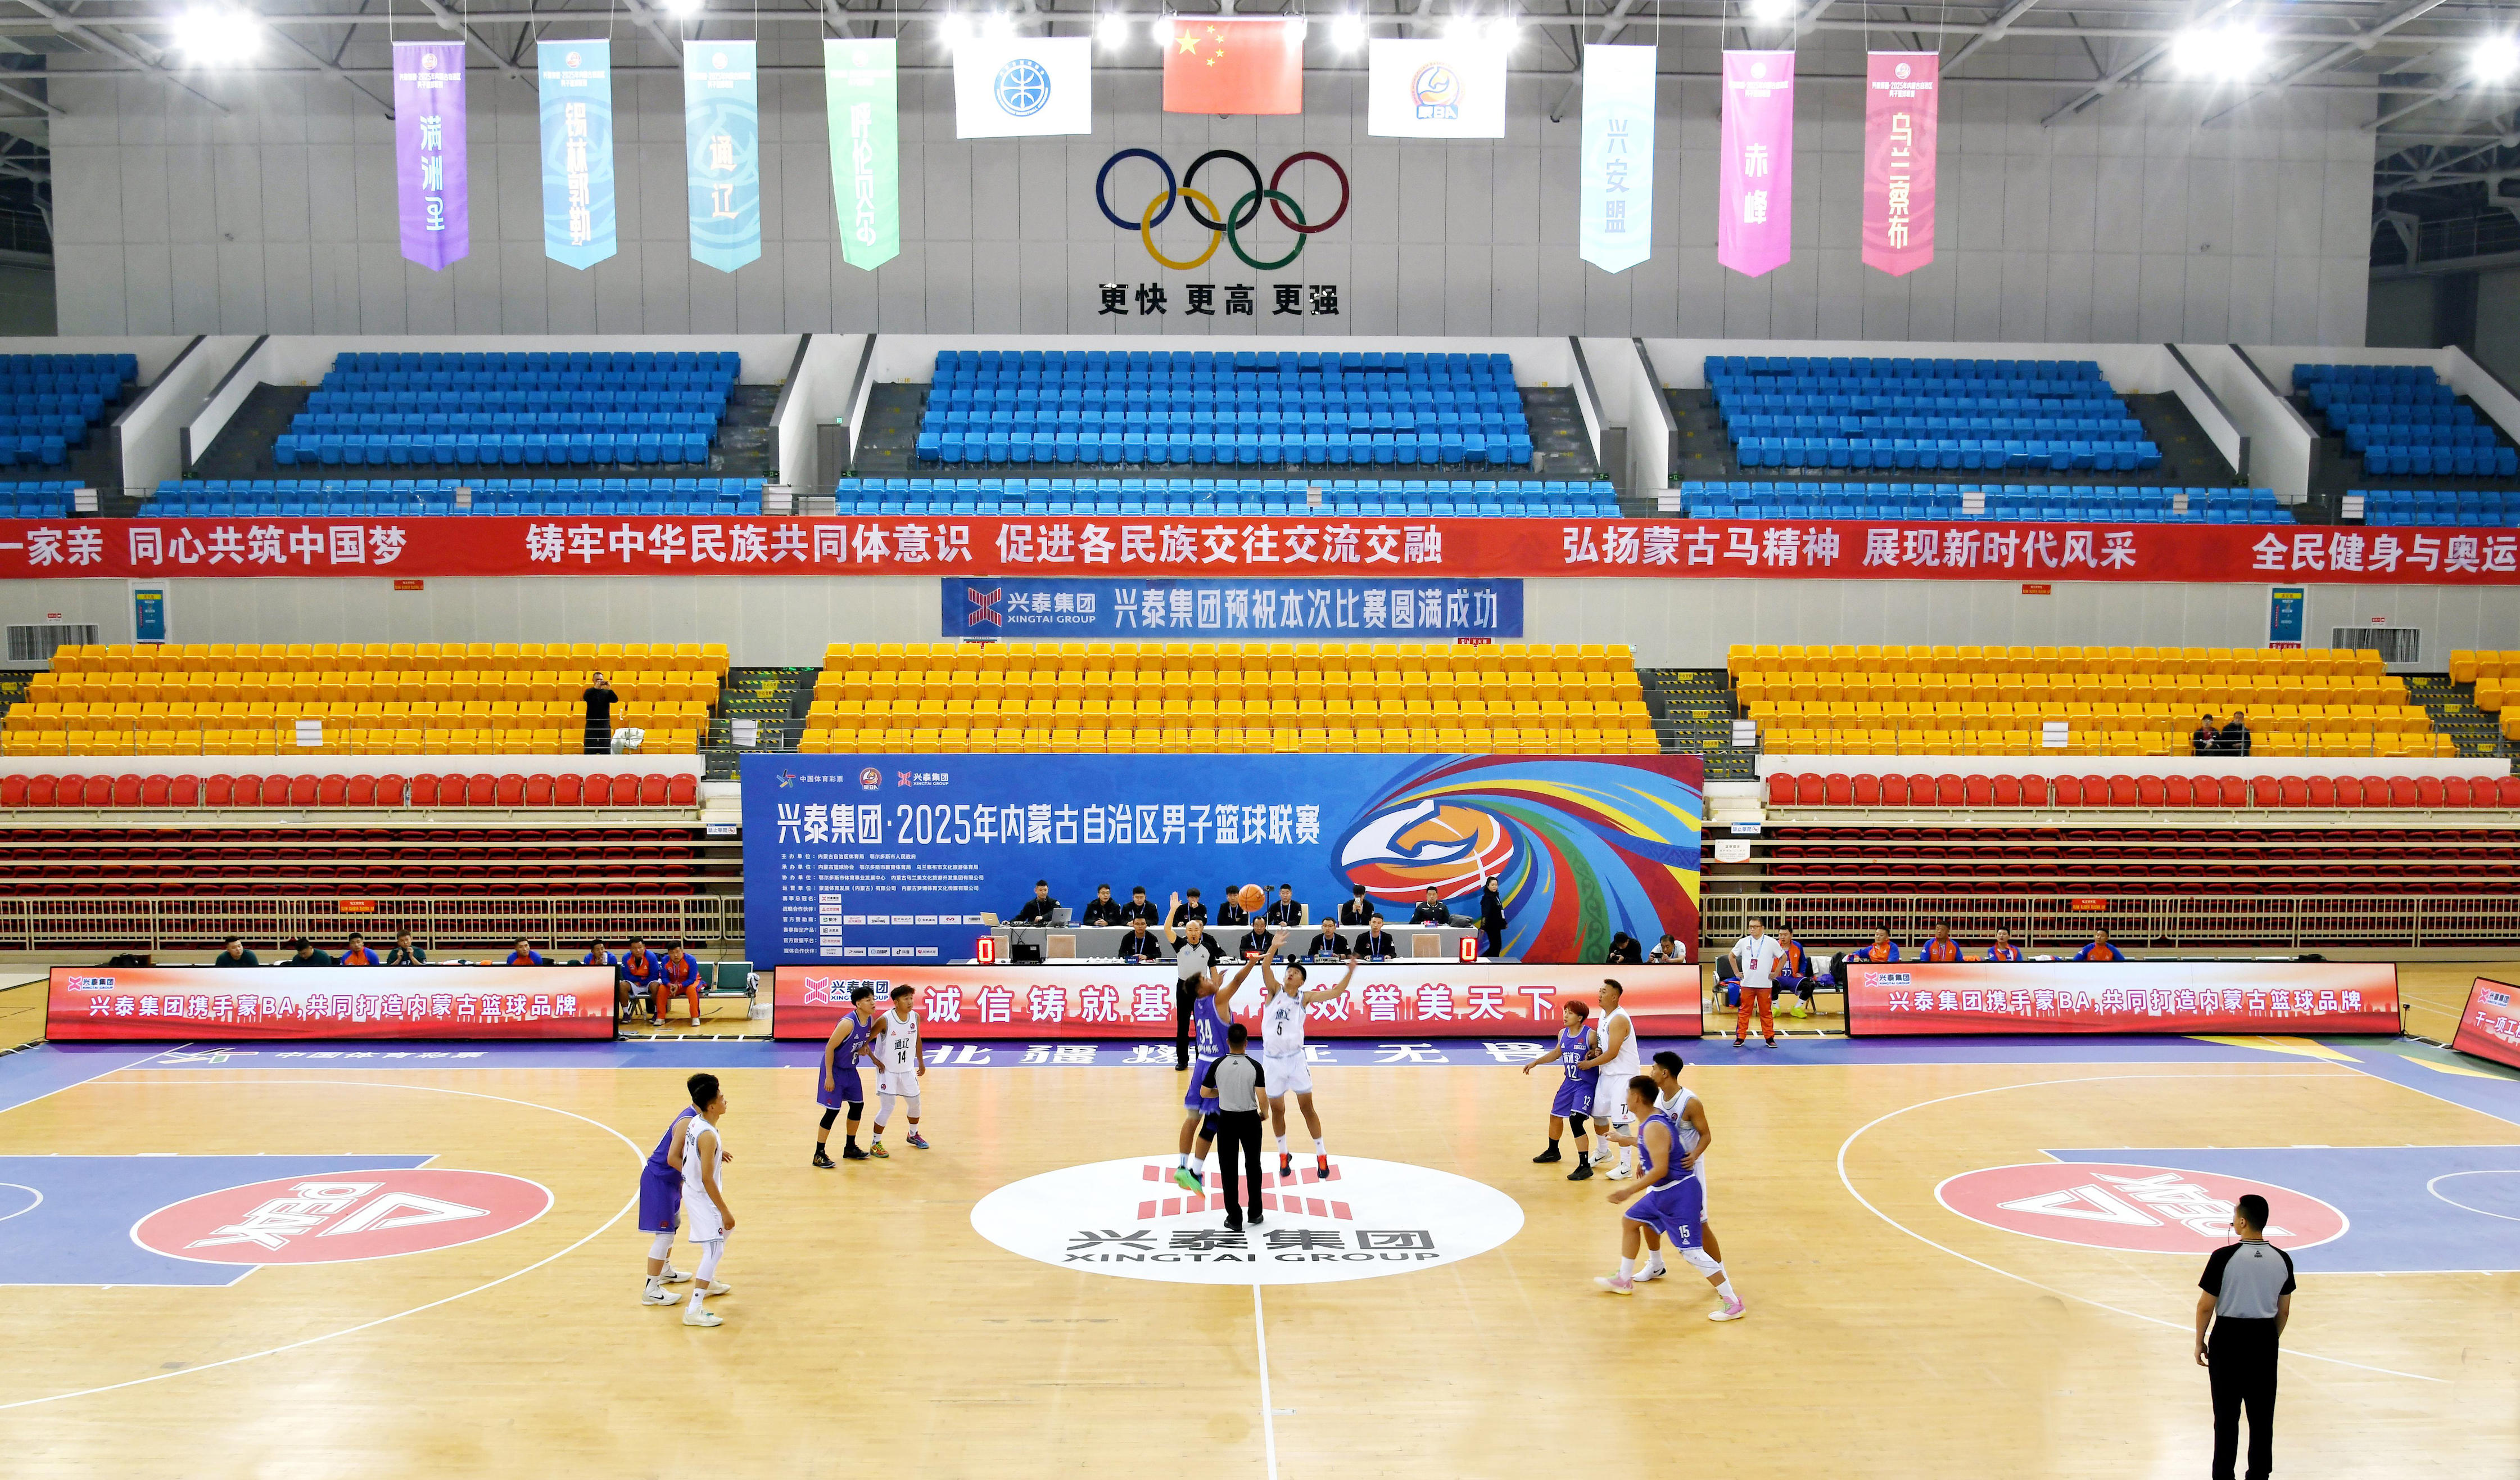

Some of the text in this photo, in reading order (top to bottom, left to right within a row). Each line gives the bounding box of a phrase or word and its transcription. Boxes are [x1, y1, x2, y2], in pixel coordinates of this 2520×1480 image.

[420, 115, 445, 231] 满洲里
[565, 102, 591, 246] 锡林郭勒
[711, 135, 738, 219] 通辽
[850, 102, 876, 246] 呼伦贝尔
[1604, 119, 1630, 233] 兴安盟
[1744, 142, 1768, 225] 赤峰
[1888, 112, 1912, 249] 乌兰察布
[1099, 283, 1340, 315] 更快 更高 更强
[129, 525, 408, 566] 同心共筑中国梦
[526, 522, 974, 564] 铸牢中华民族共同体意识
[996, 523, 1443, 564] 促进各民族交往交流交融
[1562, 526, 1839, 567] 弘扬蒙古马精神
[1862, 528, 2136, 570] 展现新时代风采
[2251, 531, 2518, 573] 全民健身与奥运
[1007, 593, 1096, 614] 兴泰集团
[1114, 588, 1498, 630] 兴泰集团预祝本次比赛圆满成功
[1007, 615, 1096, 624] XINGTAI GROUP
[913, 773, 949, 782] 兴泰集团
[777, 803, 1321, 845] 兴泰集团·2025年内蒙古自治区男子篮球联赛
[979, 939, 993, 962] 0
[1462, 938, 1476, 960] 0
[83, 977, 114, 987] 兴泰集团
[1879, 973, 1910, 982] 兴泰集团
[89, 995, 577, 1017] 兴泰集团携手蒙BA,共同打造内蒙古篮球品牌
[1889, 989, 2361, 1013] 兴泰集团携手蒙BA,共同打造内蒙古篮球品牌
[1197, 1018, 1213, 1045] 34
[275, 1050, 490, 1059] 中国体育彩票
[894, 1038, 910, 1050] 通辽
[898, 1050, 906, 1064] 14
[1567, 1064, 1577, 1079] 12
[1584, 1095, 1591, 1106] 12
[1066, 1229, 1435, 1251] 兴泰集团
[1678, 1224, 1690, 1238] 15
[1061, 1253, 1440, 1262] XINGTAI GROUP
